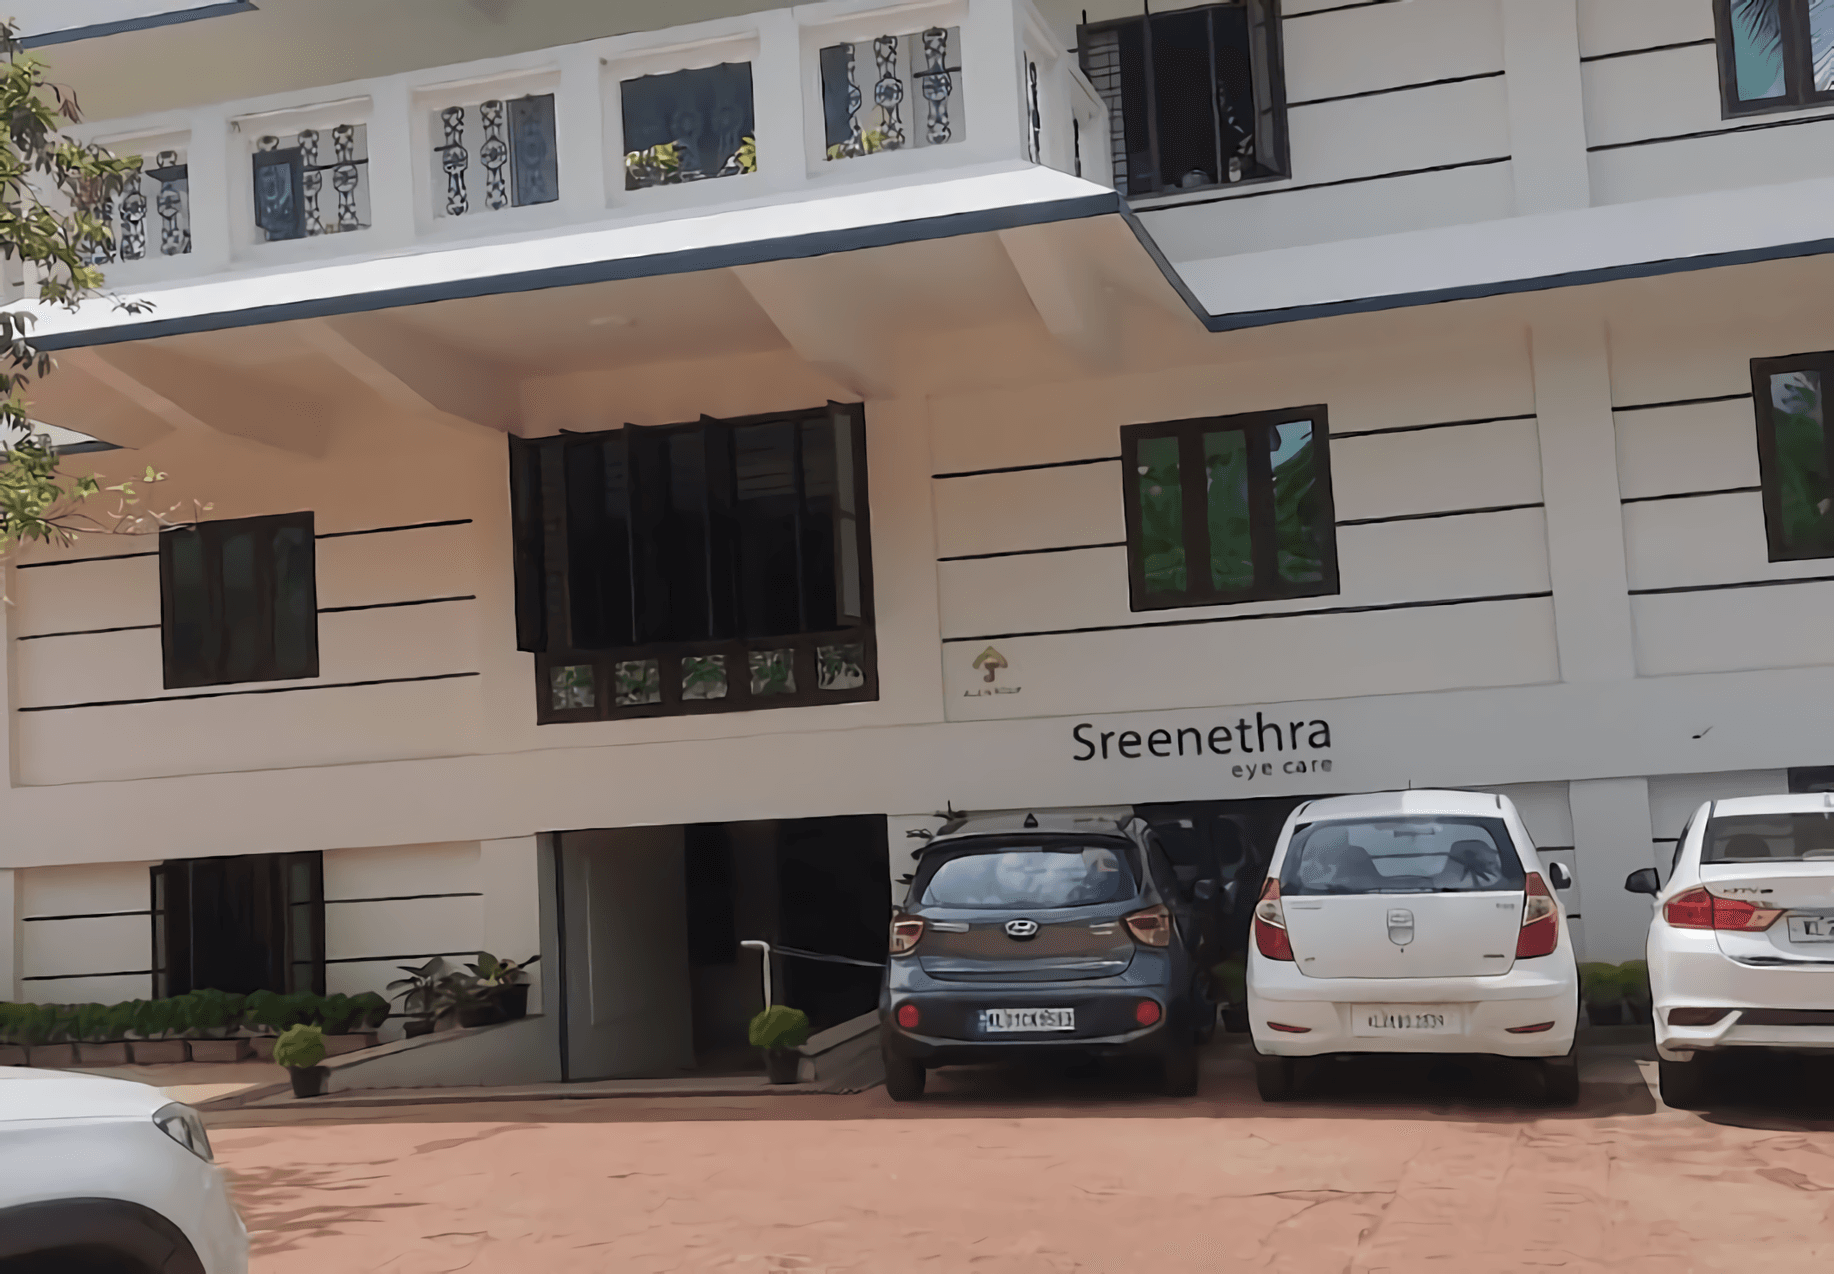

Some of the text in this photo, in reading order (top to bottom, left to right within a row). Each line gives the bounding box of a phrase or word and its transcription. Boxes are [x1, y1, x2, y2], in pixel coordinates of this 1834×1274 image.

[1073, 712, 1331, 761] Sreenethra
[1231, 759, 1332, 781] eye care
